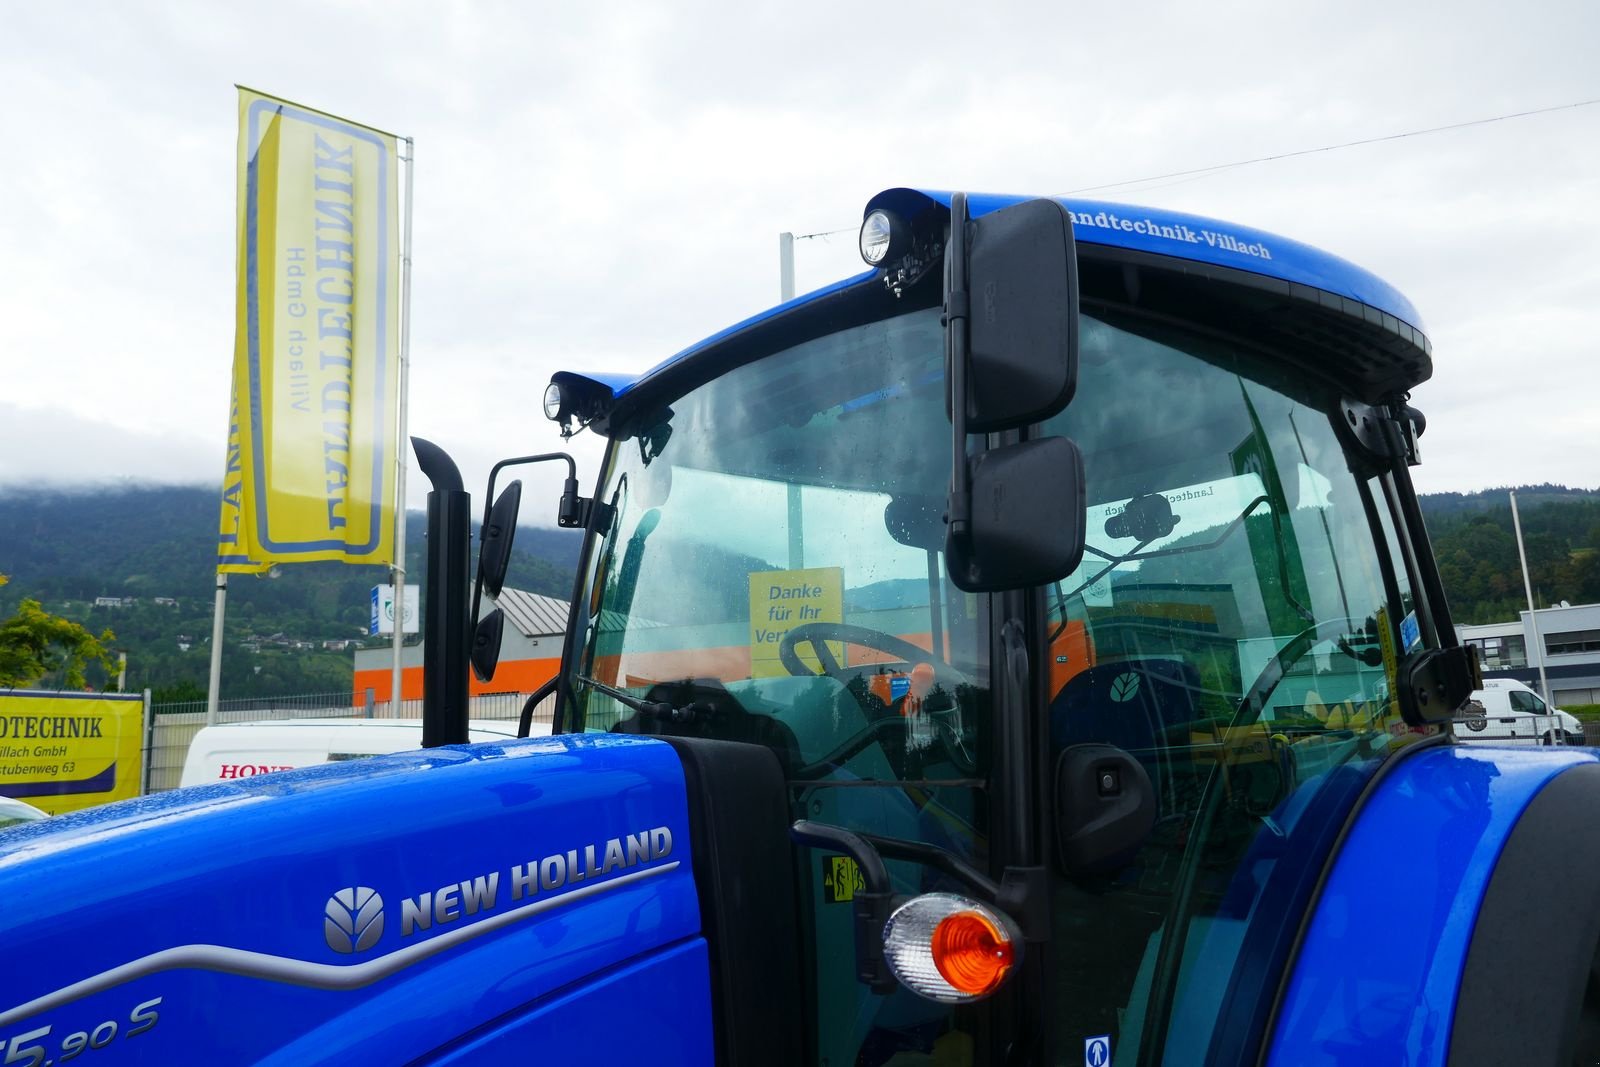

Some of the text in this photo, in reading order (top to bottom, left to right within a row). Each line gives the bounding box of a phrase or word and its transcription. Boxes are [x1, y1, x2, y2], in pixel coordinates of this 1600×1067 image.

[769, 584, 822, 600] Danke
[768, 605, 822, 621] für Ihr
[33, 746, 67, 757] GmbH
[62, 762, 75, 773] 63
[400, 826, 673, 938] NEW HOLLAND
[0, 996, 163, 1067] 5.90 S
